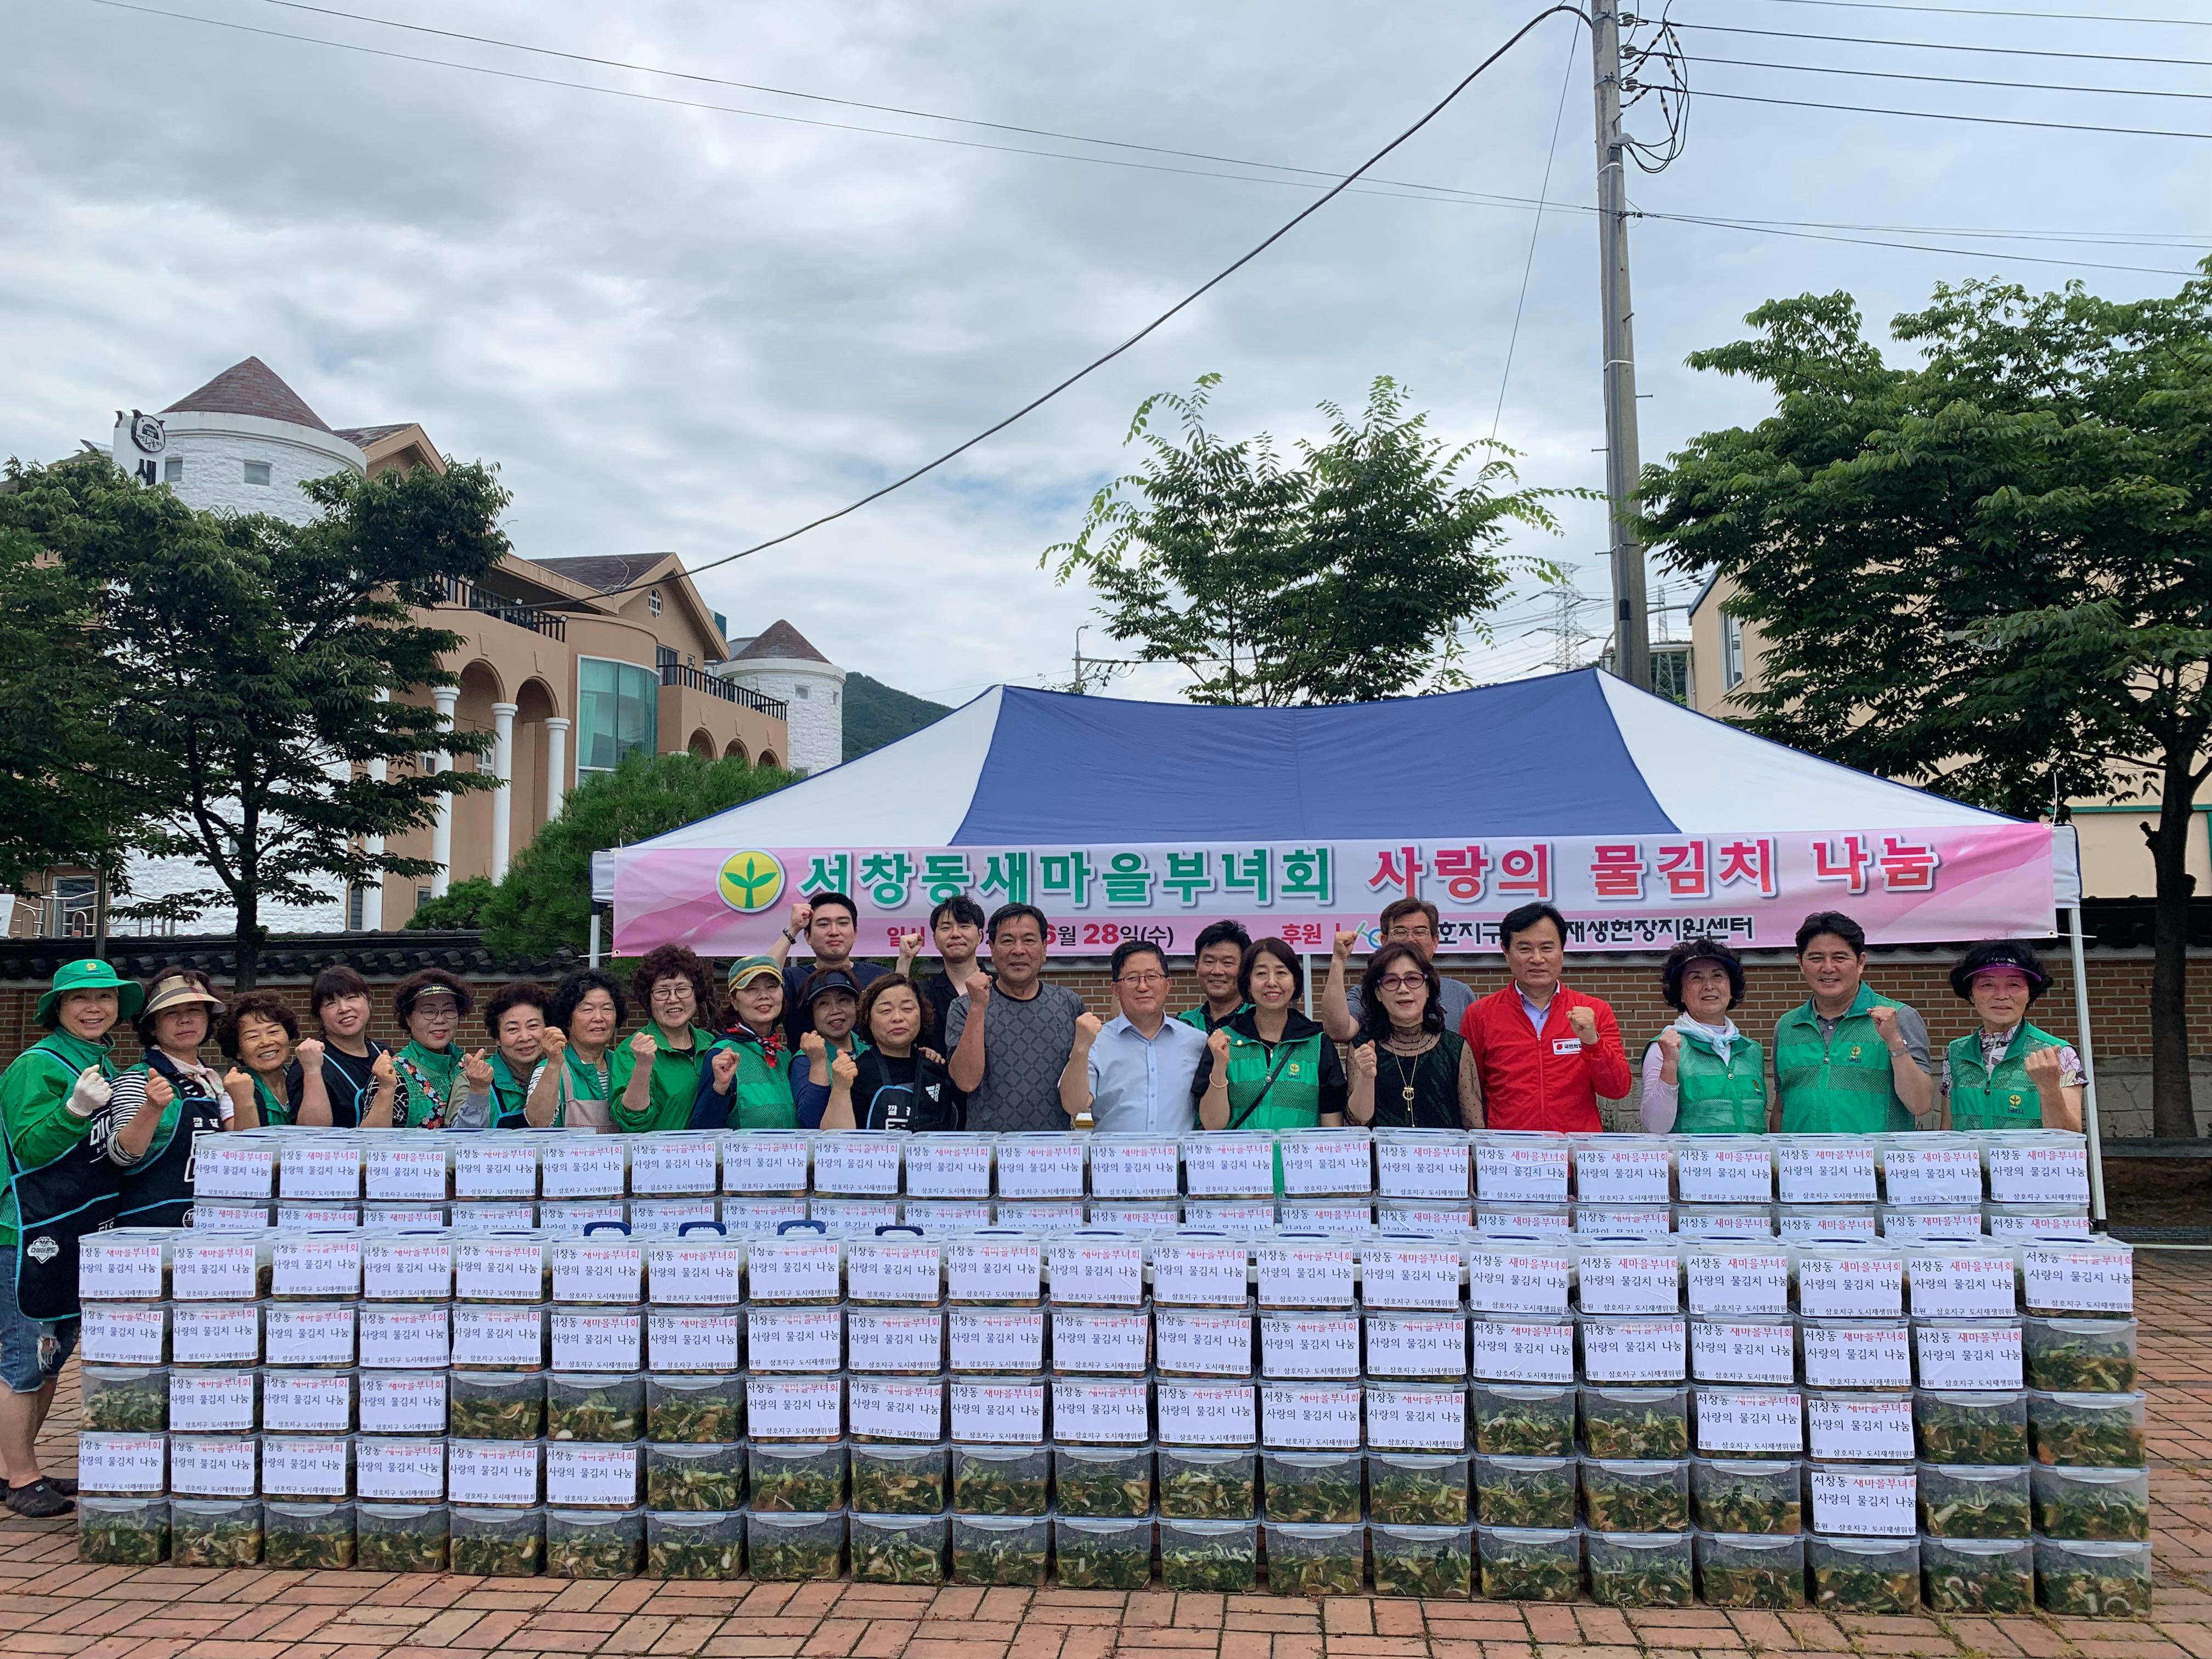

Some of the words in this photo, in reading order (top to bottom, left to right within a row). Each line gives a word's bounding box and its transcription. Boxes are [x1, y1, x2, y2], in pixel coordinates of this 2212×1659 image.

[799, 848, 1329, 905] 서창동새마을부녀회
[1367, 844, 1549, 899] 사랑의
[1590, 839, 1773, 896] 물김치
[1812, 836, 1935, 890] 나눔
[1281, 923, 1322, 945] 후원
[1438, 922, 1502, 944] 호지구
[1566, 917, 1753, 943] 재생현장지원센터
[724, 1143, 750, 1153] 서창동
[1186, 1144, 1212, 1155] 서창동
[1217, 1144, 1272, 1155] 새마을부녀회
[1380, 1146, 1408, 1157] 서창동
[1413, 1147, 1469, 1158] 새마을부녀회
[1780, 1149, 1810, 1160] 서창동
[1815, 1148, 1873, 1160] 새마을부녀회
[195, 1149, 217, 1160] 서창동
[222, 1151, 272, 1162] 새마을부녀회
[725, 1157, 751, 1168] 사랑의
[755, 1157, 782, 1168] 물김치
[787, 1158, 805, 1167] 나눔
[1188, 1160, 1215, 1170] 사랑의
[1220, 1160, 1247, 1170] 물김치
[1252, 1160, 1271, 1170] 나눔
[1382, 1162, 1410, 1173] 사랑의
[1415, 1163, 1443, 1174] 물김치
[1449, 1164, 1468, 1174] 나눔
[195, 1164, 218, 1174] 사랑의
[222, 1165, 246, 1176] 물김치
[251, 1167, 269, 1177] 나눔
[1782, 1166, 1813, 1176] 사랑의
[1818, 1165, 1848, 1176] 물김치
[1853, 1166, 1873, 1176] 나눔
[106, 1246, 159, 1257] 새마을부녀회
[552, 1249, 578, 1260] 서창동
[583, 1249, 640, 1260] 새마을부녀회
[107, 1263, 133, 1274] 물김치
[138, 1263, 157, 1274] 나눔
[1472, 1255, 1504, 1267] 서창동
[1508, 1257, 1568, 1271] 새마을부녀회
[1801, 1261, 1833, 1273] 서창동
[1838, 1261, 1901, 1273] 새마을부녀회
[552, 1265, 580, 1276] 사랑의
[584, 1265, 612, 1277] 물김치
[618, 1266, 637, 1277] 나눔
[1473, 1272, 1504, 1284] 사랑의
[1510, 1274, 1541, 1288] 물김치
[1547, 1277, 1567, 1289] 나눔
[1803, 1279, 1836, 1290] 사랑의
[1842, 1279, 1874, 1290] 물김치
[1880, 1279, 1900, 1290] 나눔
[1583, 1324, 1616, 1335] 서창동
[1056, 1332, 1086, 1344] 사랑의
[1091, 1333, 1121, 1345] 물김치
[1126, 1334, 1146, 1345] 나눔
[1918, 1331, 1952, 1344] 서창동
[1957, 1331, 2022, 1344] 새마을부녀회
[1587, 1341, 1618, 1353] 사랑의
[1624, 1341, 1656, 1353] 물김치
[1662, 1340, 1683, 1352] 나눔
[1922, 1349, 1955, 1362] 사랑의
[1961, 1349, 1994, 1361] 물김치
[2000, 1348, 2021, 1361] 나눔
[388, 1379, 444, 1390] 새마을부녀회
[1159, 1389, 1187, 1400] 서창동
[1193, 1387, 1252, 1400] 새마을부녀회
[390, 1396, 417, 1407] 물김치
[422, 1397, 442, 1407] 나눔
[1160, 1405, 1190, 1417] 사랑의
[1195, 1406, 1225, 1417] 물김치
[1231, 1406, 1251, 1417] 나눔
[1700, 1411, 1733, 1423] 사랑의
[1738, 1412, 1770, 1424] 물김치
[1776, 1413, 1798, 1425] 나눔
[549, 1466, 575, 1478] 사랑의
[580, 1468, 608, 1479] 물김치
[613, 1468, 634, 1479] 나눔
[1814, 1475, 1848, 1488] 서창동
[1853, 1478, 1916, 1490] 새마을부녀회
[1817, 1493, 1850, 1506] 사랑의
[1856, 1495, 1889, 1508] 물김치
[1895, 1496, 1915, 1508] 나눔
